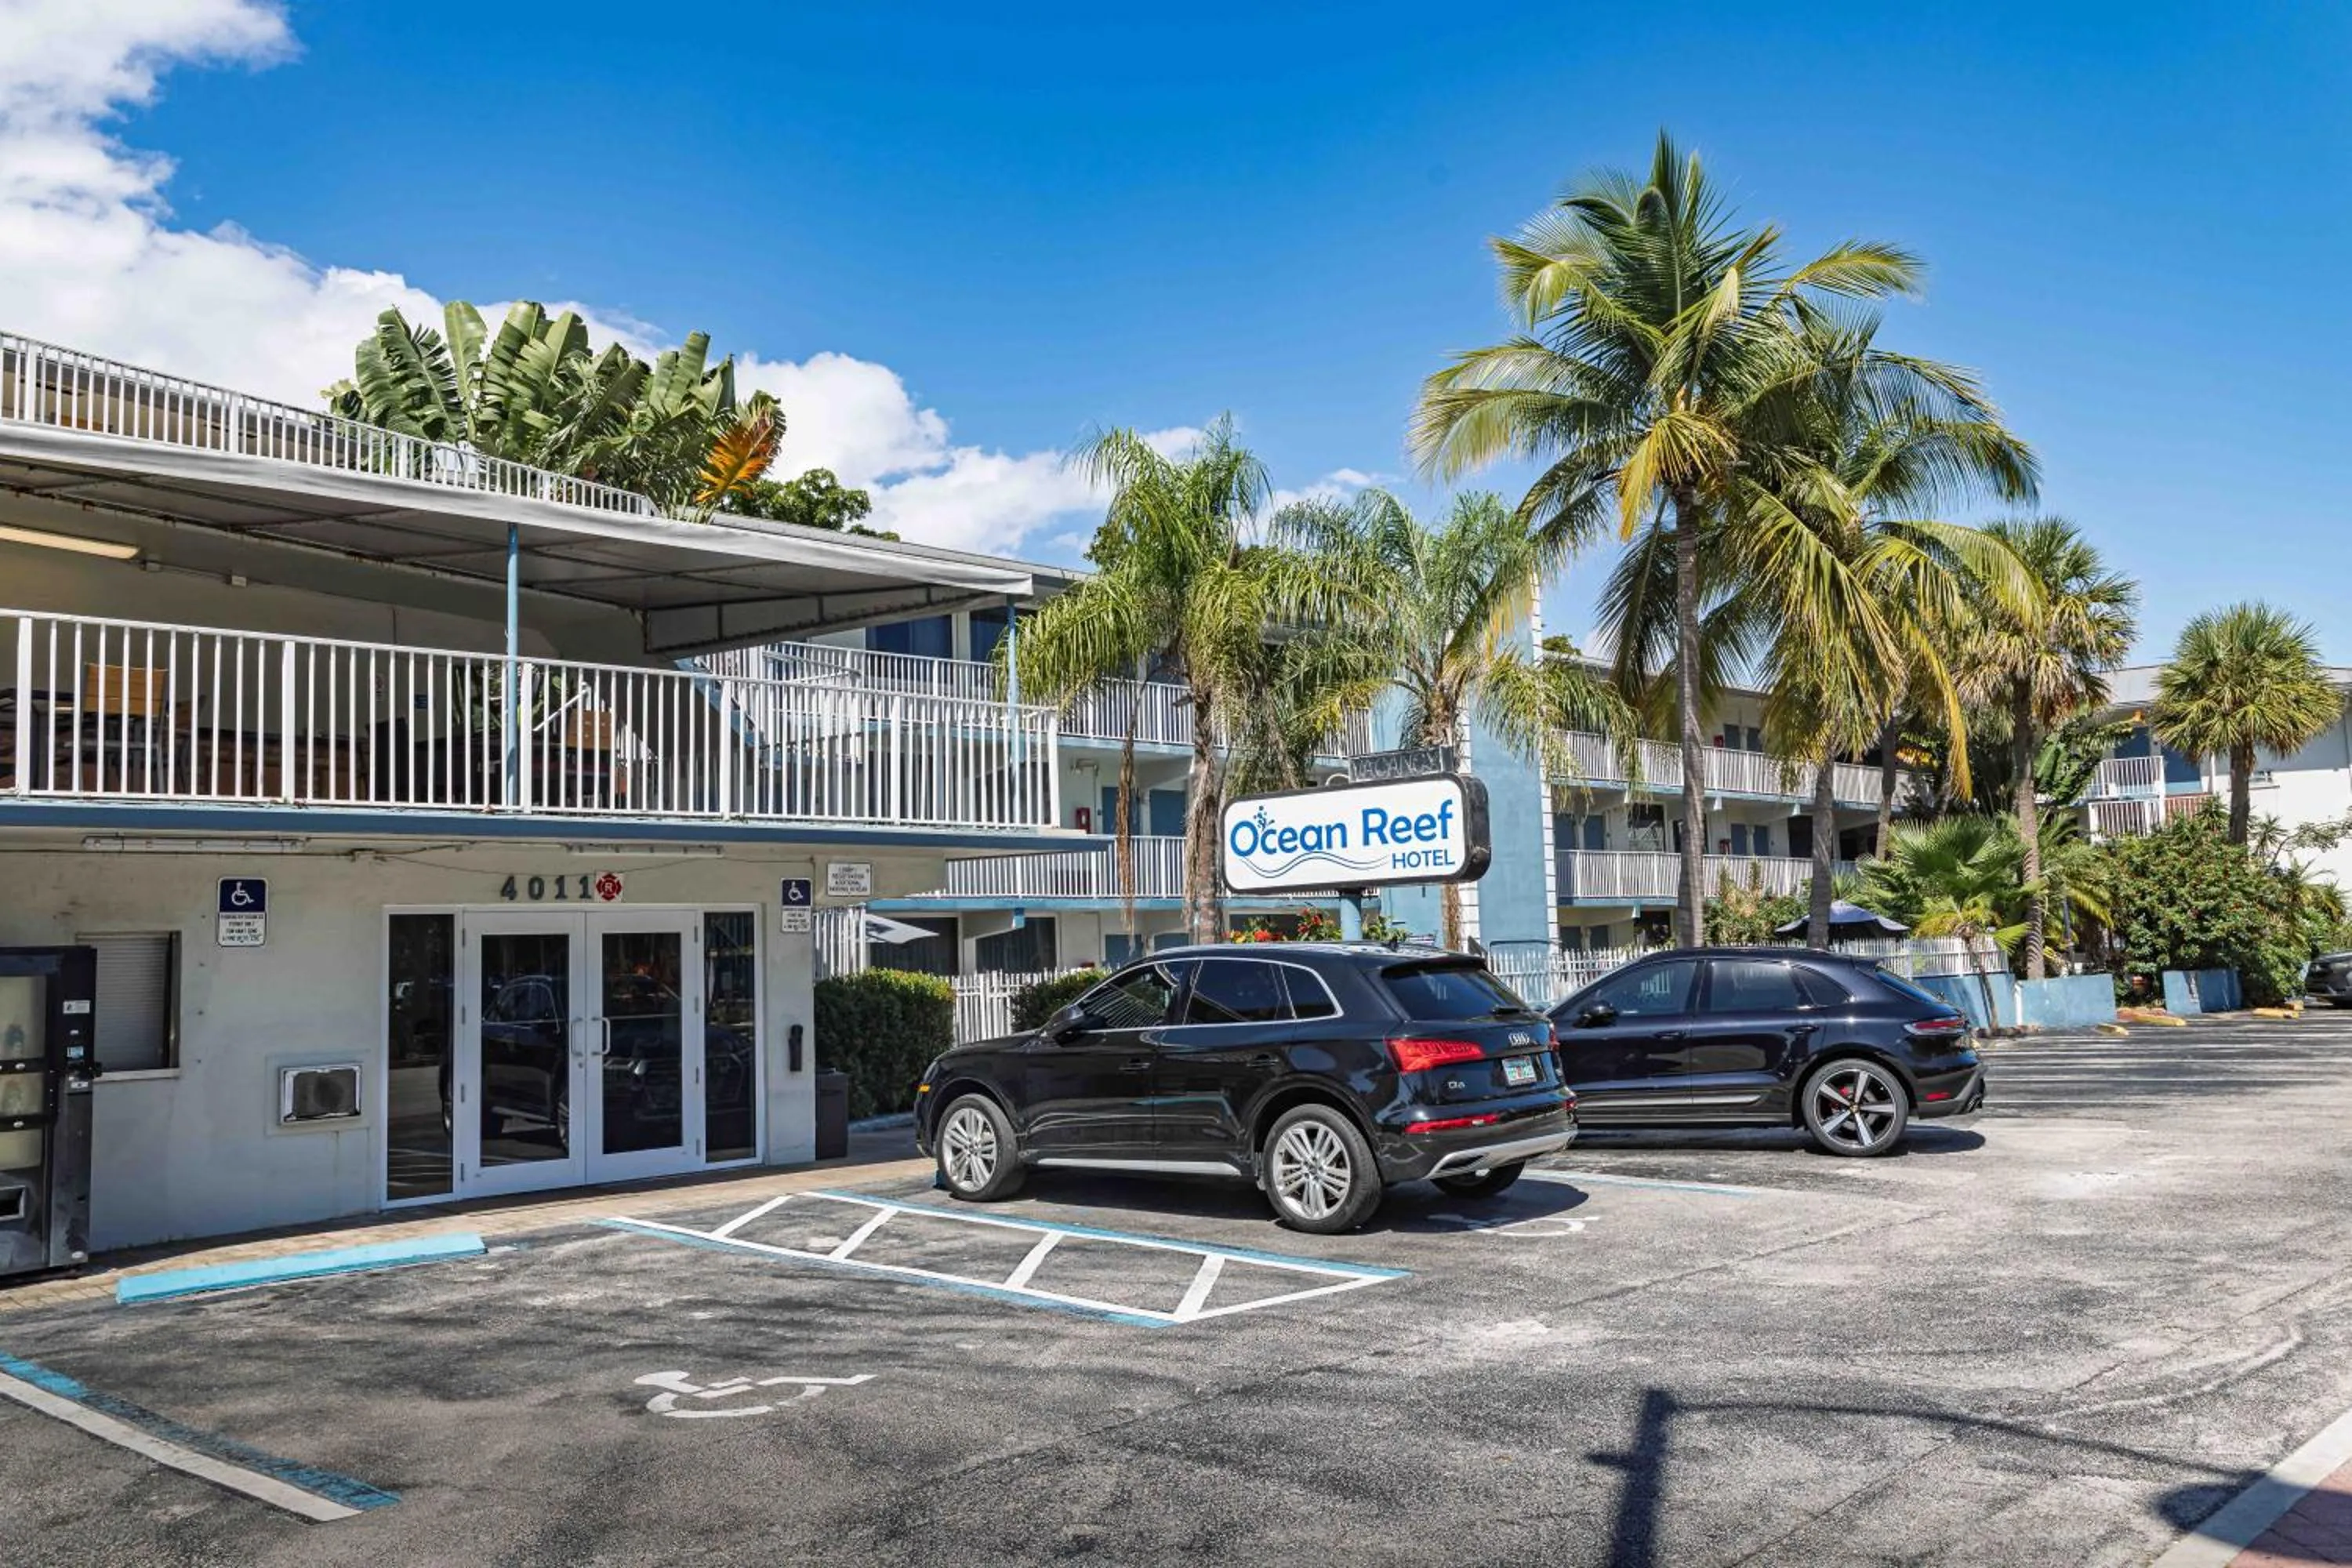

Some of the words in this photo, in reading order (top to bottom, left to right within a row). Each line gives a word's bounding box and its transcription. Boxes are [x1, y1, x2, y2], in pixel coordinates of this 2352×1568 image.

[1230, 819, 1348, 858] Ocean
[1361, 799, 1454, 848] Reef
[1392, 849, 1456, 869] HOTEL
[500, 875, 592, 901] 4011
